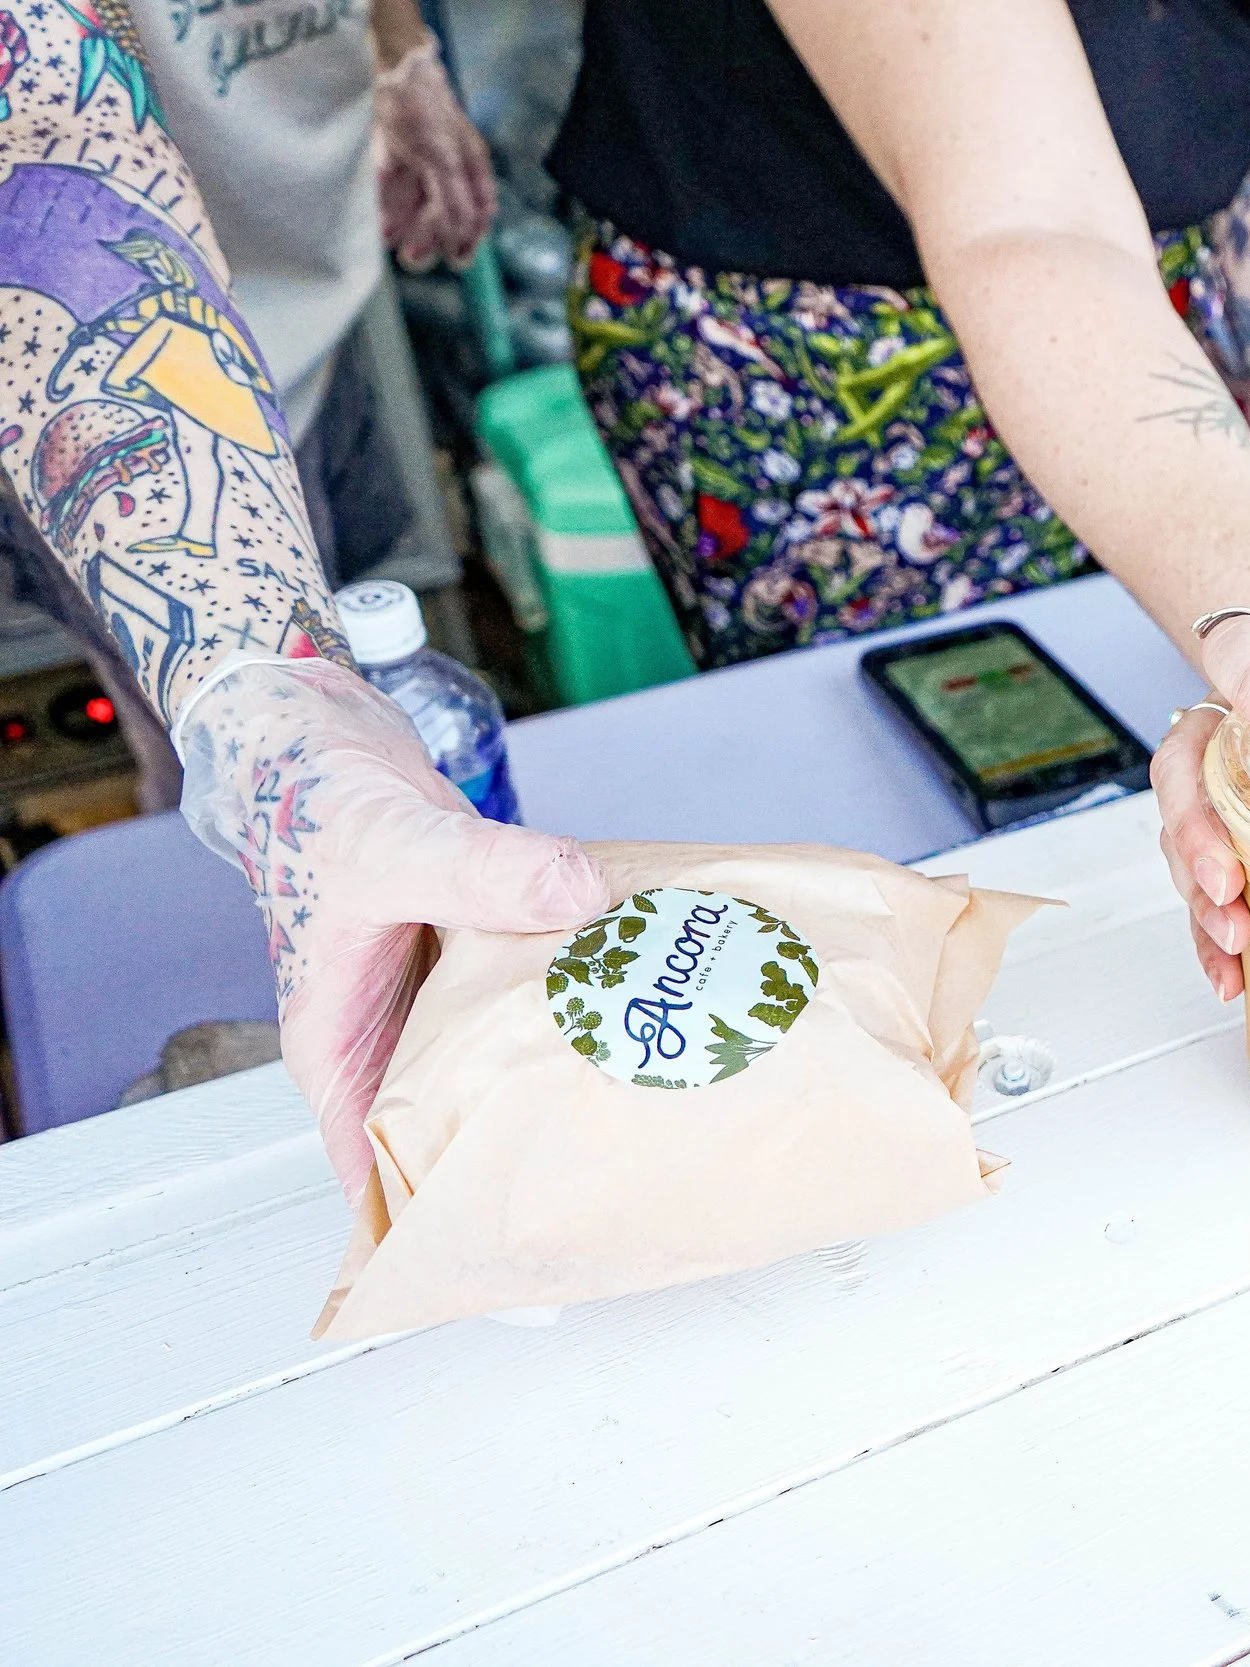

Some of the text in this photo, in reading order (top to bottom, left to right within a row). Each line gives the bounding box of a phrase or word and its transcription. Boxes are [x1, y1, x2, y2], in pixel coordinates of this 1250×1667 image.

[623, 903, 729, 1070] Ancora
[695, 966, 712, 992] cafe
[711, 919, 739, 952] bakery
